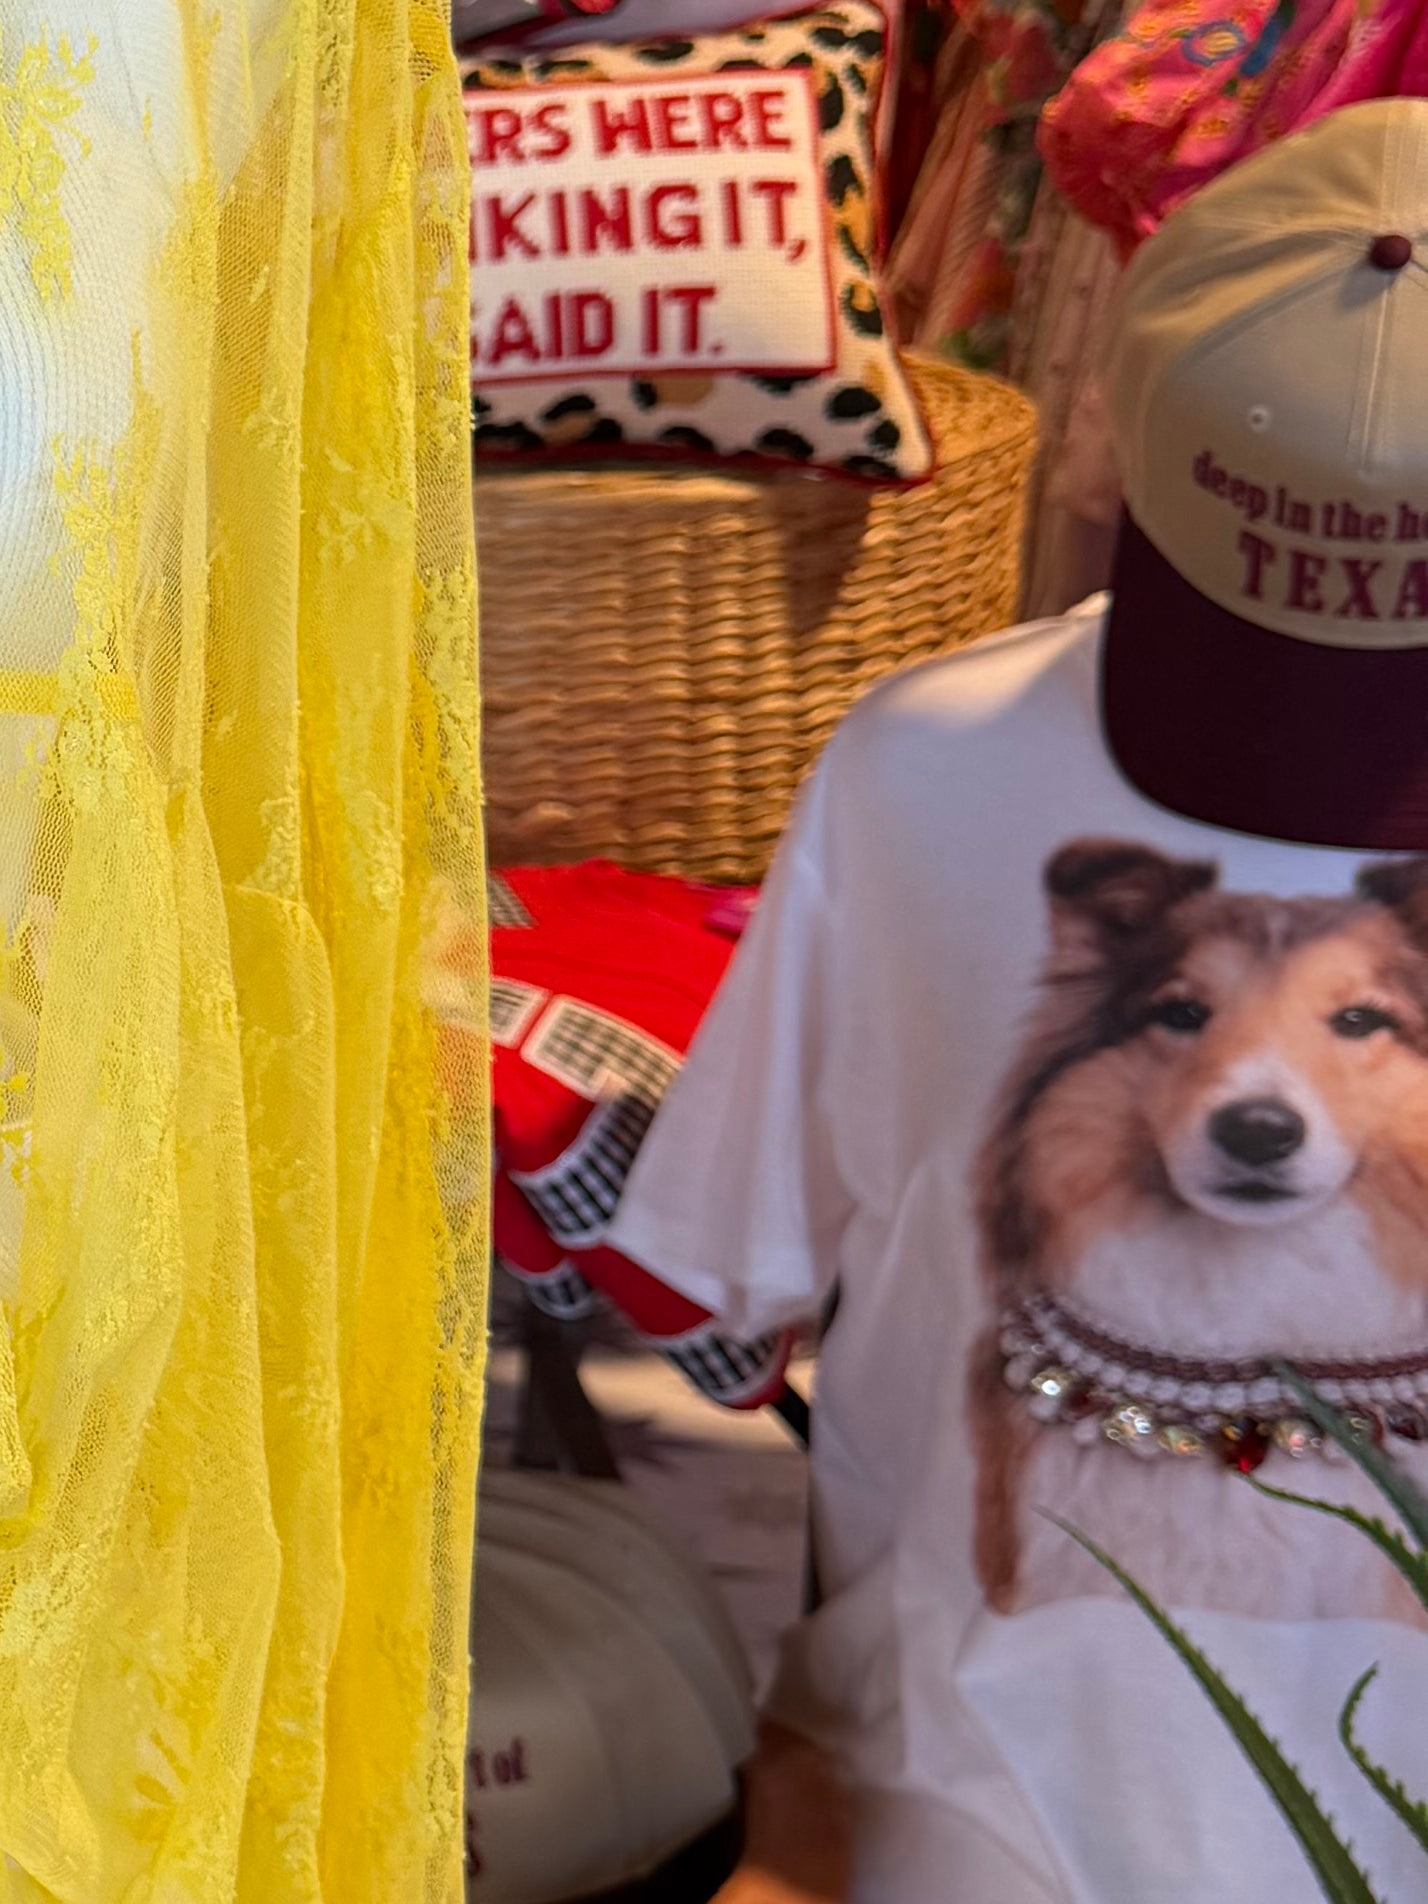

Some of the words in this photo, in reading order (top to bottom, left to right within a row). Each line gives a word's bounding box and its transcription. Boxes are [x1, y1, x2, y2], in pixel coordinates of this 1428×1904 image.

[467, 102, 572, 166] RS
[469, 181, 703, 264] KING
[718, 179, 808, 266] IT,
[469, 290, 616, 364] AID
[639, 284, 723, 358] IT.
[1192, 449, 1269, 524] deep
[1273, 484, 1313, 534] in
[1322, 499, 1390, 543] the
